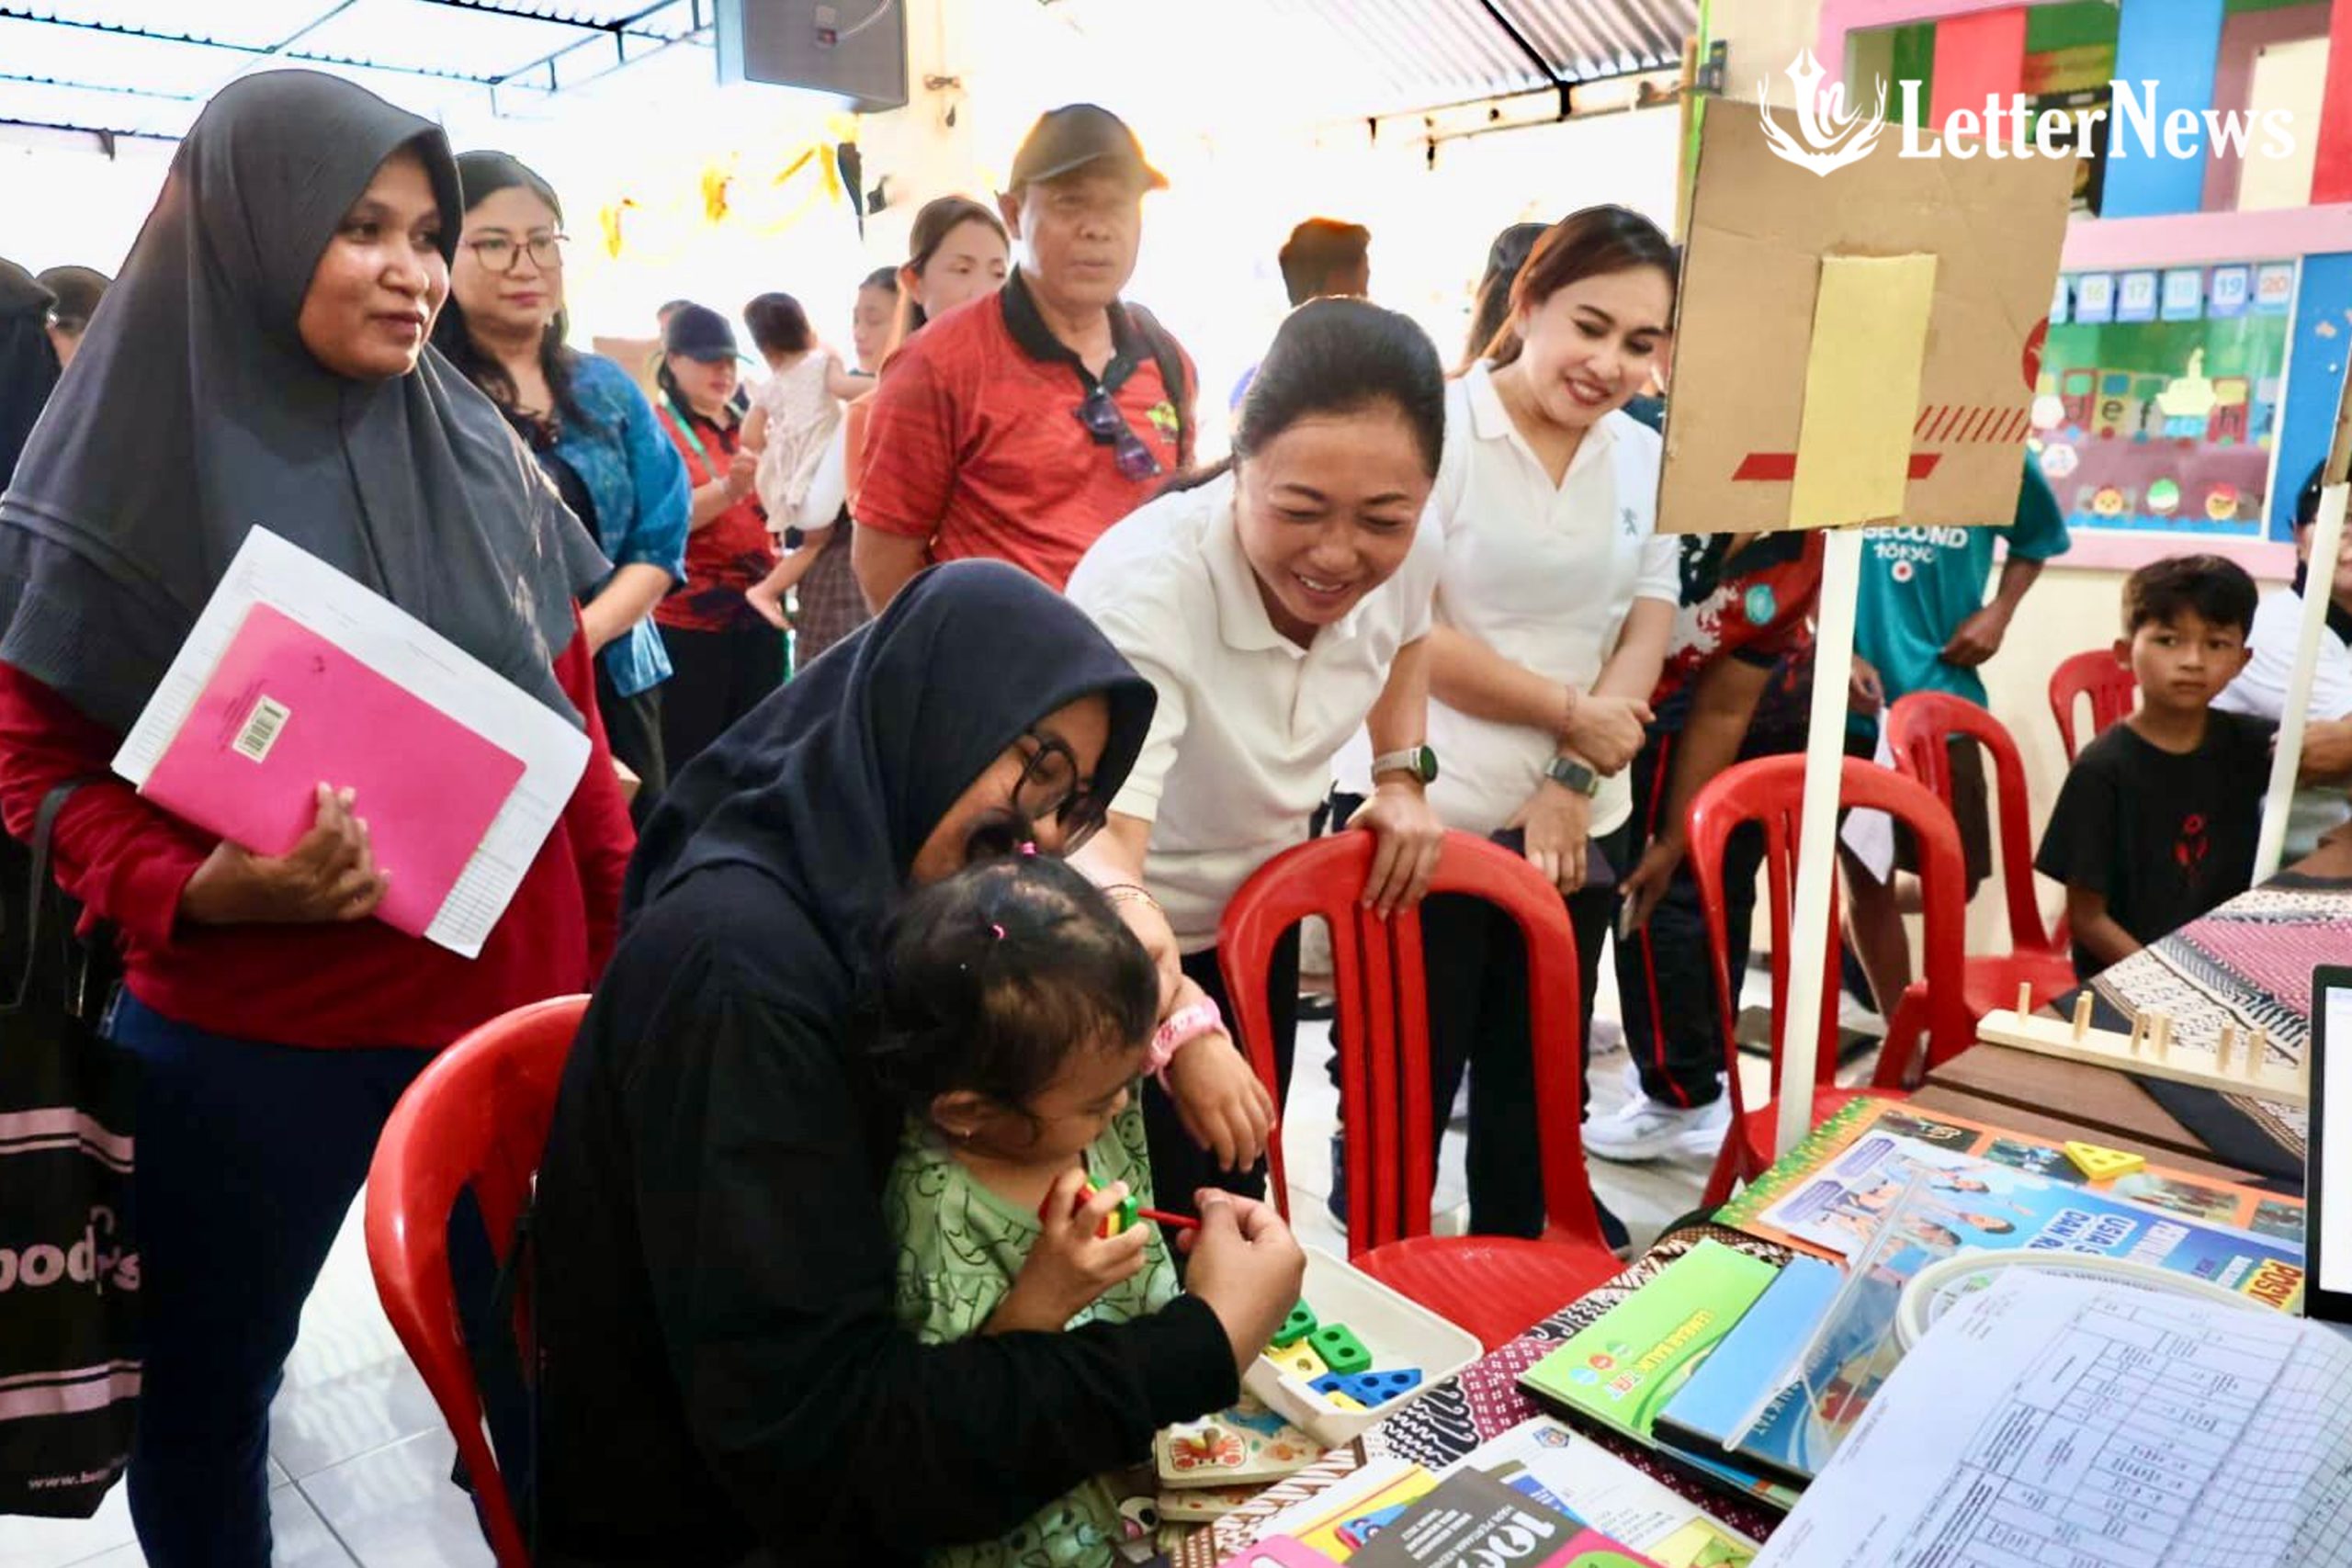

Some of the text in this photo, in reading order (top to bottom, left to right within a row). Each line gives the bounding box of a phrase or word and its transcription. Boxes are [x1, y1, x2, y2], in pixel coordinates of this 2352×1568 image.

[2127, 279, 2149, 299] 17
[2219, 276, 2244, 295] 19
[2263, 275, 2286, 295] 20
[2101, 400, 2123, 422] e
[1863, 525, 1968, 548] SECOND
[1873, 542, 1936, 563] TOKYO
[2041, 1210, 2090, 1241] DAN
[2092, 1213, 2137, 1247] USIA
[2249, 1259, 2303, 1309] POSY
